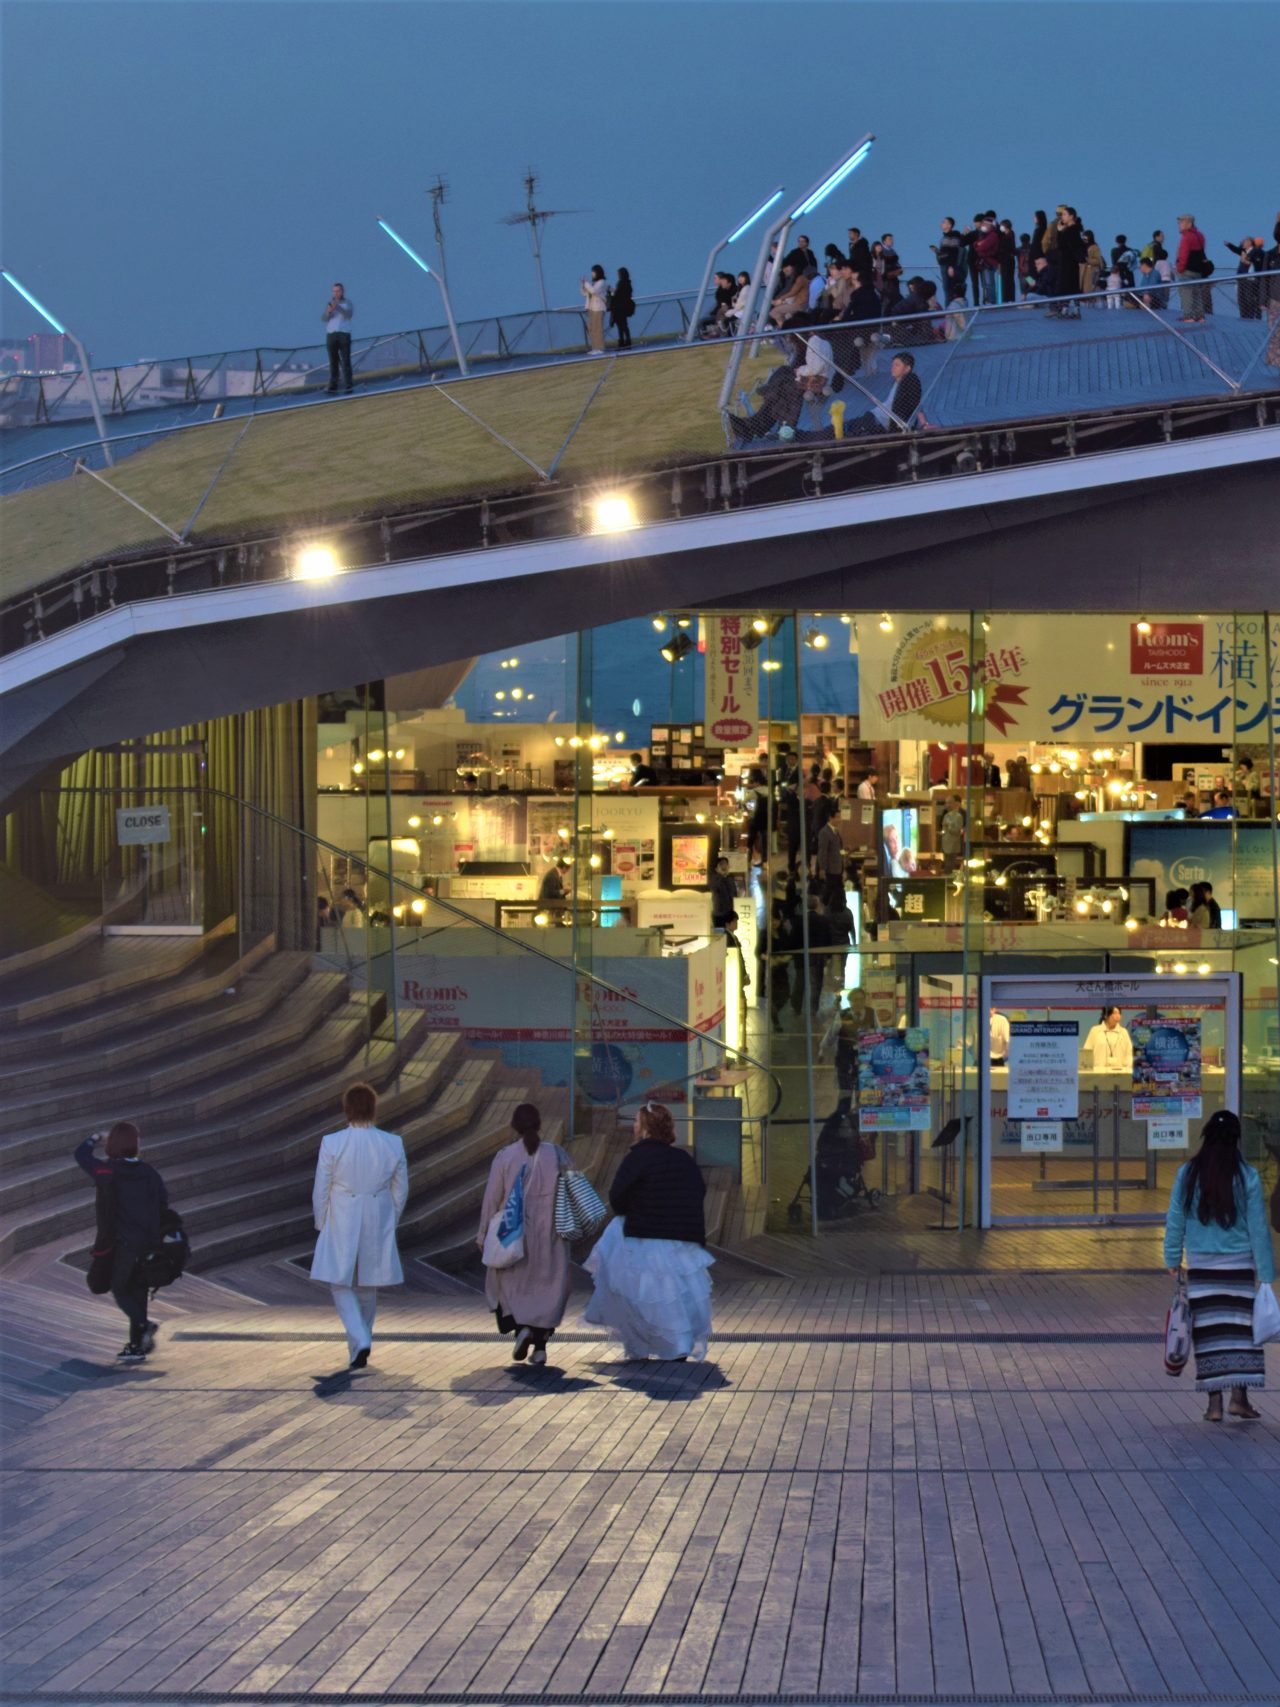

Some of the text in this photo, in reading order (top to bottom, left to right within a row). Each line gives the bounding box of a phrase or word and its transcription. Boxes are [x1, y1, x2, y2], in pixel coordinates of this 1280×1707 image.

[720, 615, 741, 714] 特別セール
[877, 645, 1026, 720] 開催15周年
[1140, 677, 1169, 687] since
[124, 815, 162, 829] CLOSE
[1178, 864, 1204, 881] Serta
[403, 980, 468, 1000] Room's
[1033, 1026, 1062, 1034] INTERIOR
[1063, 1025, 1077, 1034] FAIR
[1154, 1036, 1180, 1050] 横浜
[881, 1045, 908, 1059] 横浜
[1026, 1132, 1057, 1142] 出口専用
[1152, 1130, 1183, 1139] 出口専用
